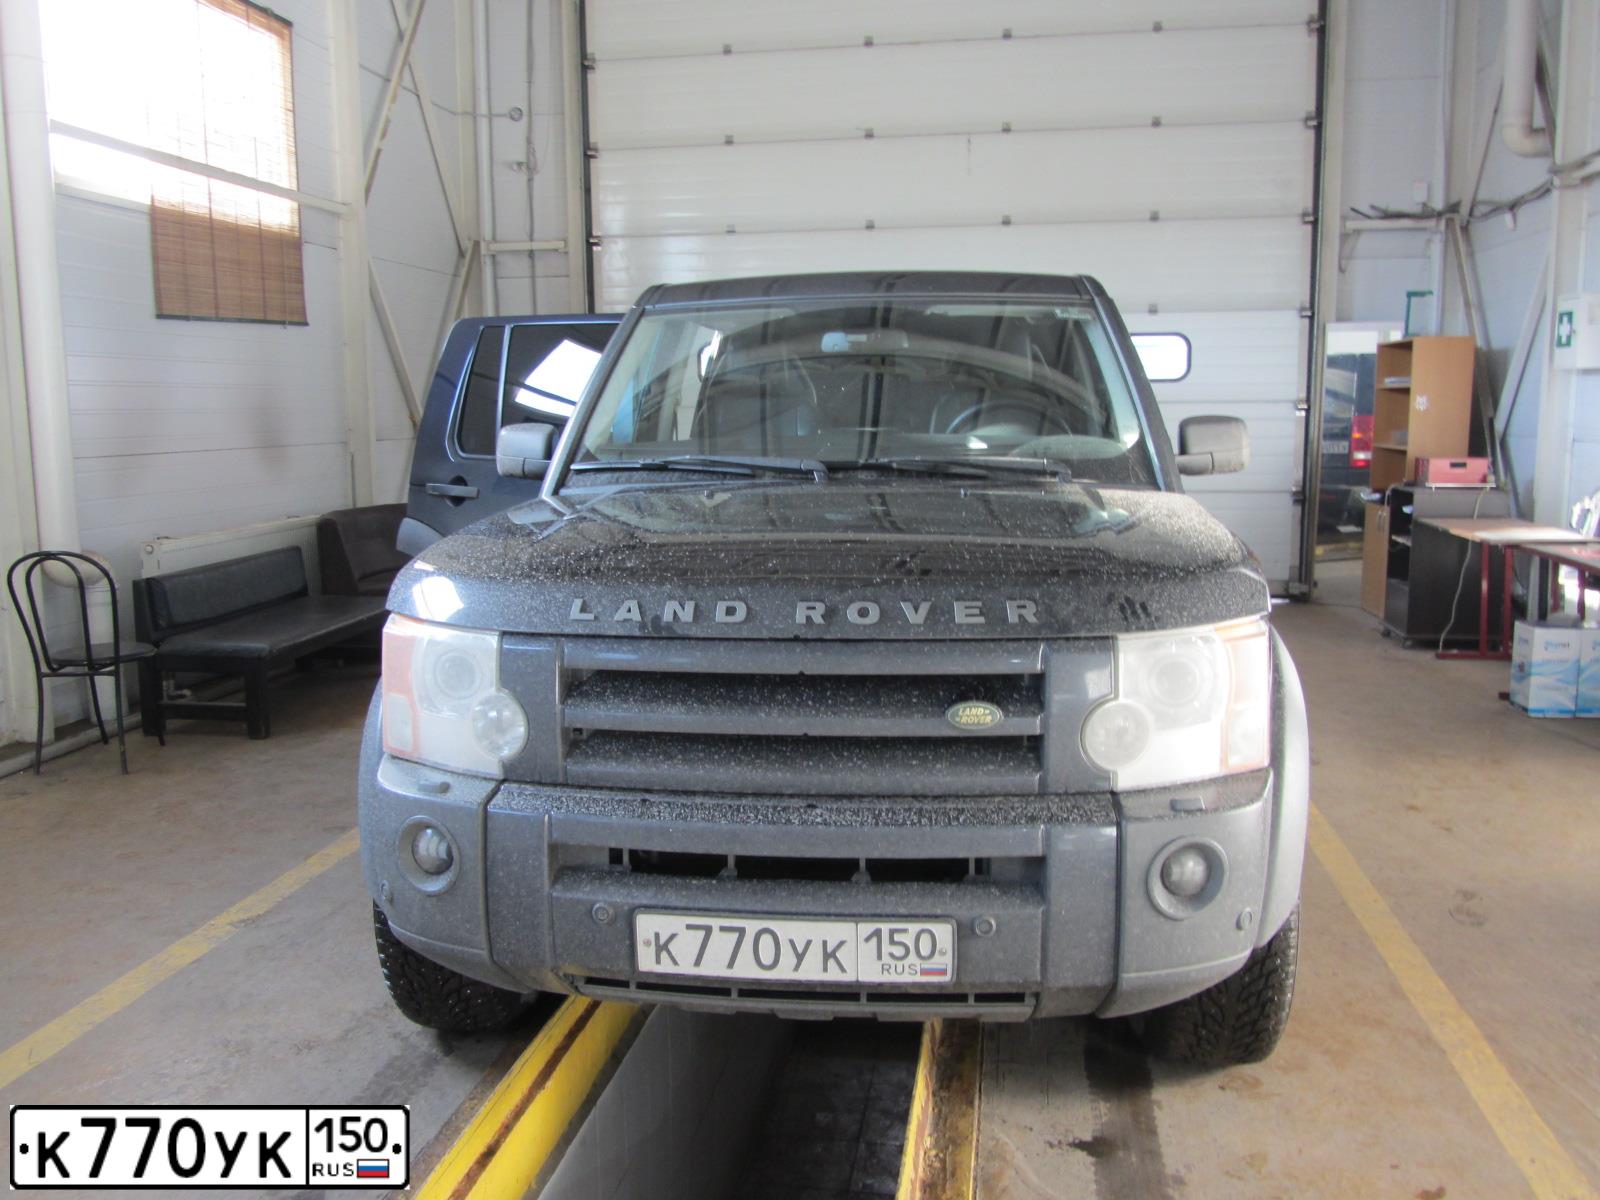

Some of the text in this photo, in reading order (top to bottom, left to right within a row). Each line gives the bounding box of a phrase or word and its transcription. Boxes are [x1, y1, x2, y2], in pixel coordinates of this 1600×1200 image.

[568, 599, 1040, 625] LAND ROVER
[863, 927, 939, 962] 150
[881, 963, 919, 977] RUS
